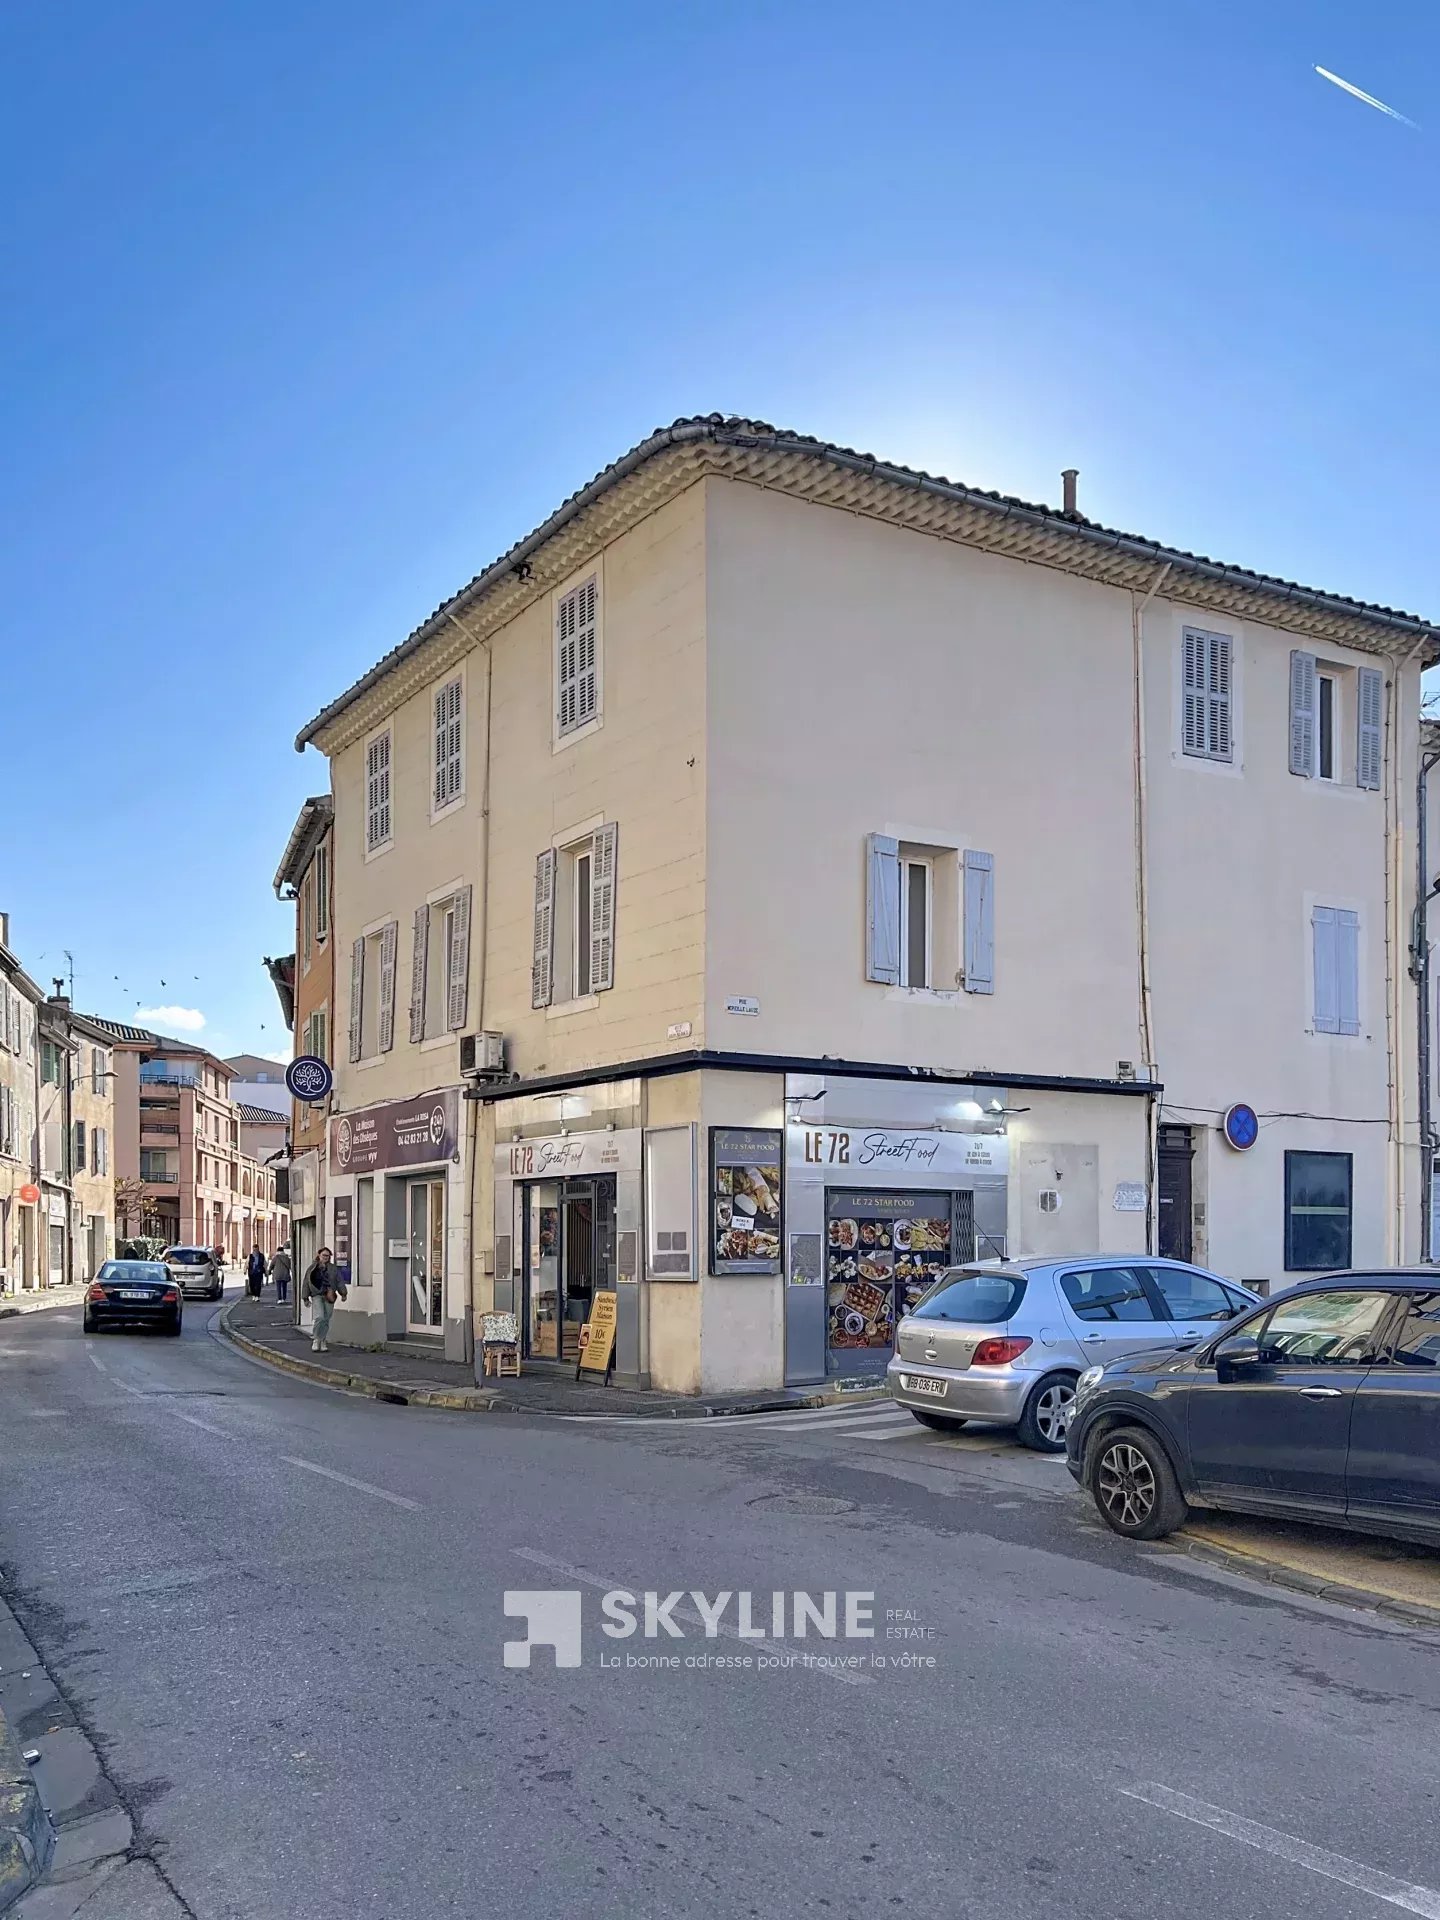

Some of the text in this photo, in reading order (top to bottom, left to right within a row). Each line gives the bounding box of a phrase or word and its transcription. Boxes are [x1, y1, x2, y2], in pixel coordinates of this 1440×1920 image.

[510, 1142, 585, 1175] LE 72 Street Food
[805, 1132, 940, 1167] LE 72 Street Food
[852, 1198, 862, 1206] LE
[863, 1198, 873, 1206] 72
[874, 1199, 893, 1207] STAR
